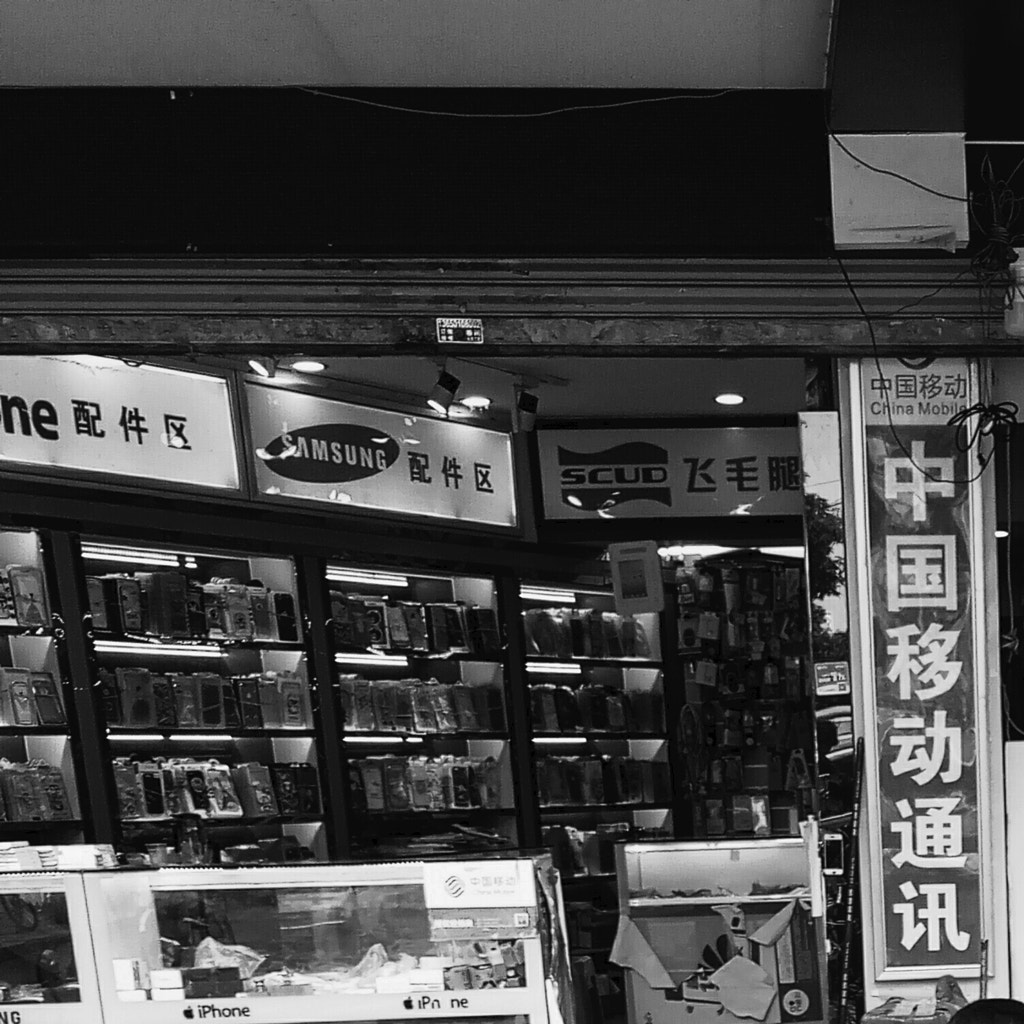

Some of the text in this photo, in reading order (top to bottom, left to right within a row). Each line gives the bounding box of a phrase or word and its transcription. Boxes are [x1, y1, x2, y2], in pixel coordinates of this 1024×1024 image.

[871, 374, 967, 399] 中国移动
[0, 395, 192, 450] ne 配件区
[871, 401, 967, 415] China Mobile
[282, 434, 494, 493] SAMSUNG 配件区
[561, 456, 801, 493] SCUD 飞毛腿
[884, 440, 971, 952] 中国移动通讯
[198, 1004, 251, 1019] iPhone
[418, 996, 469, 1010] iPhne
